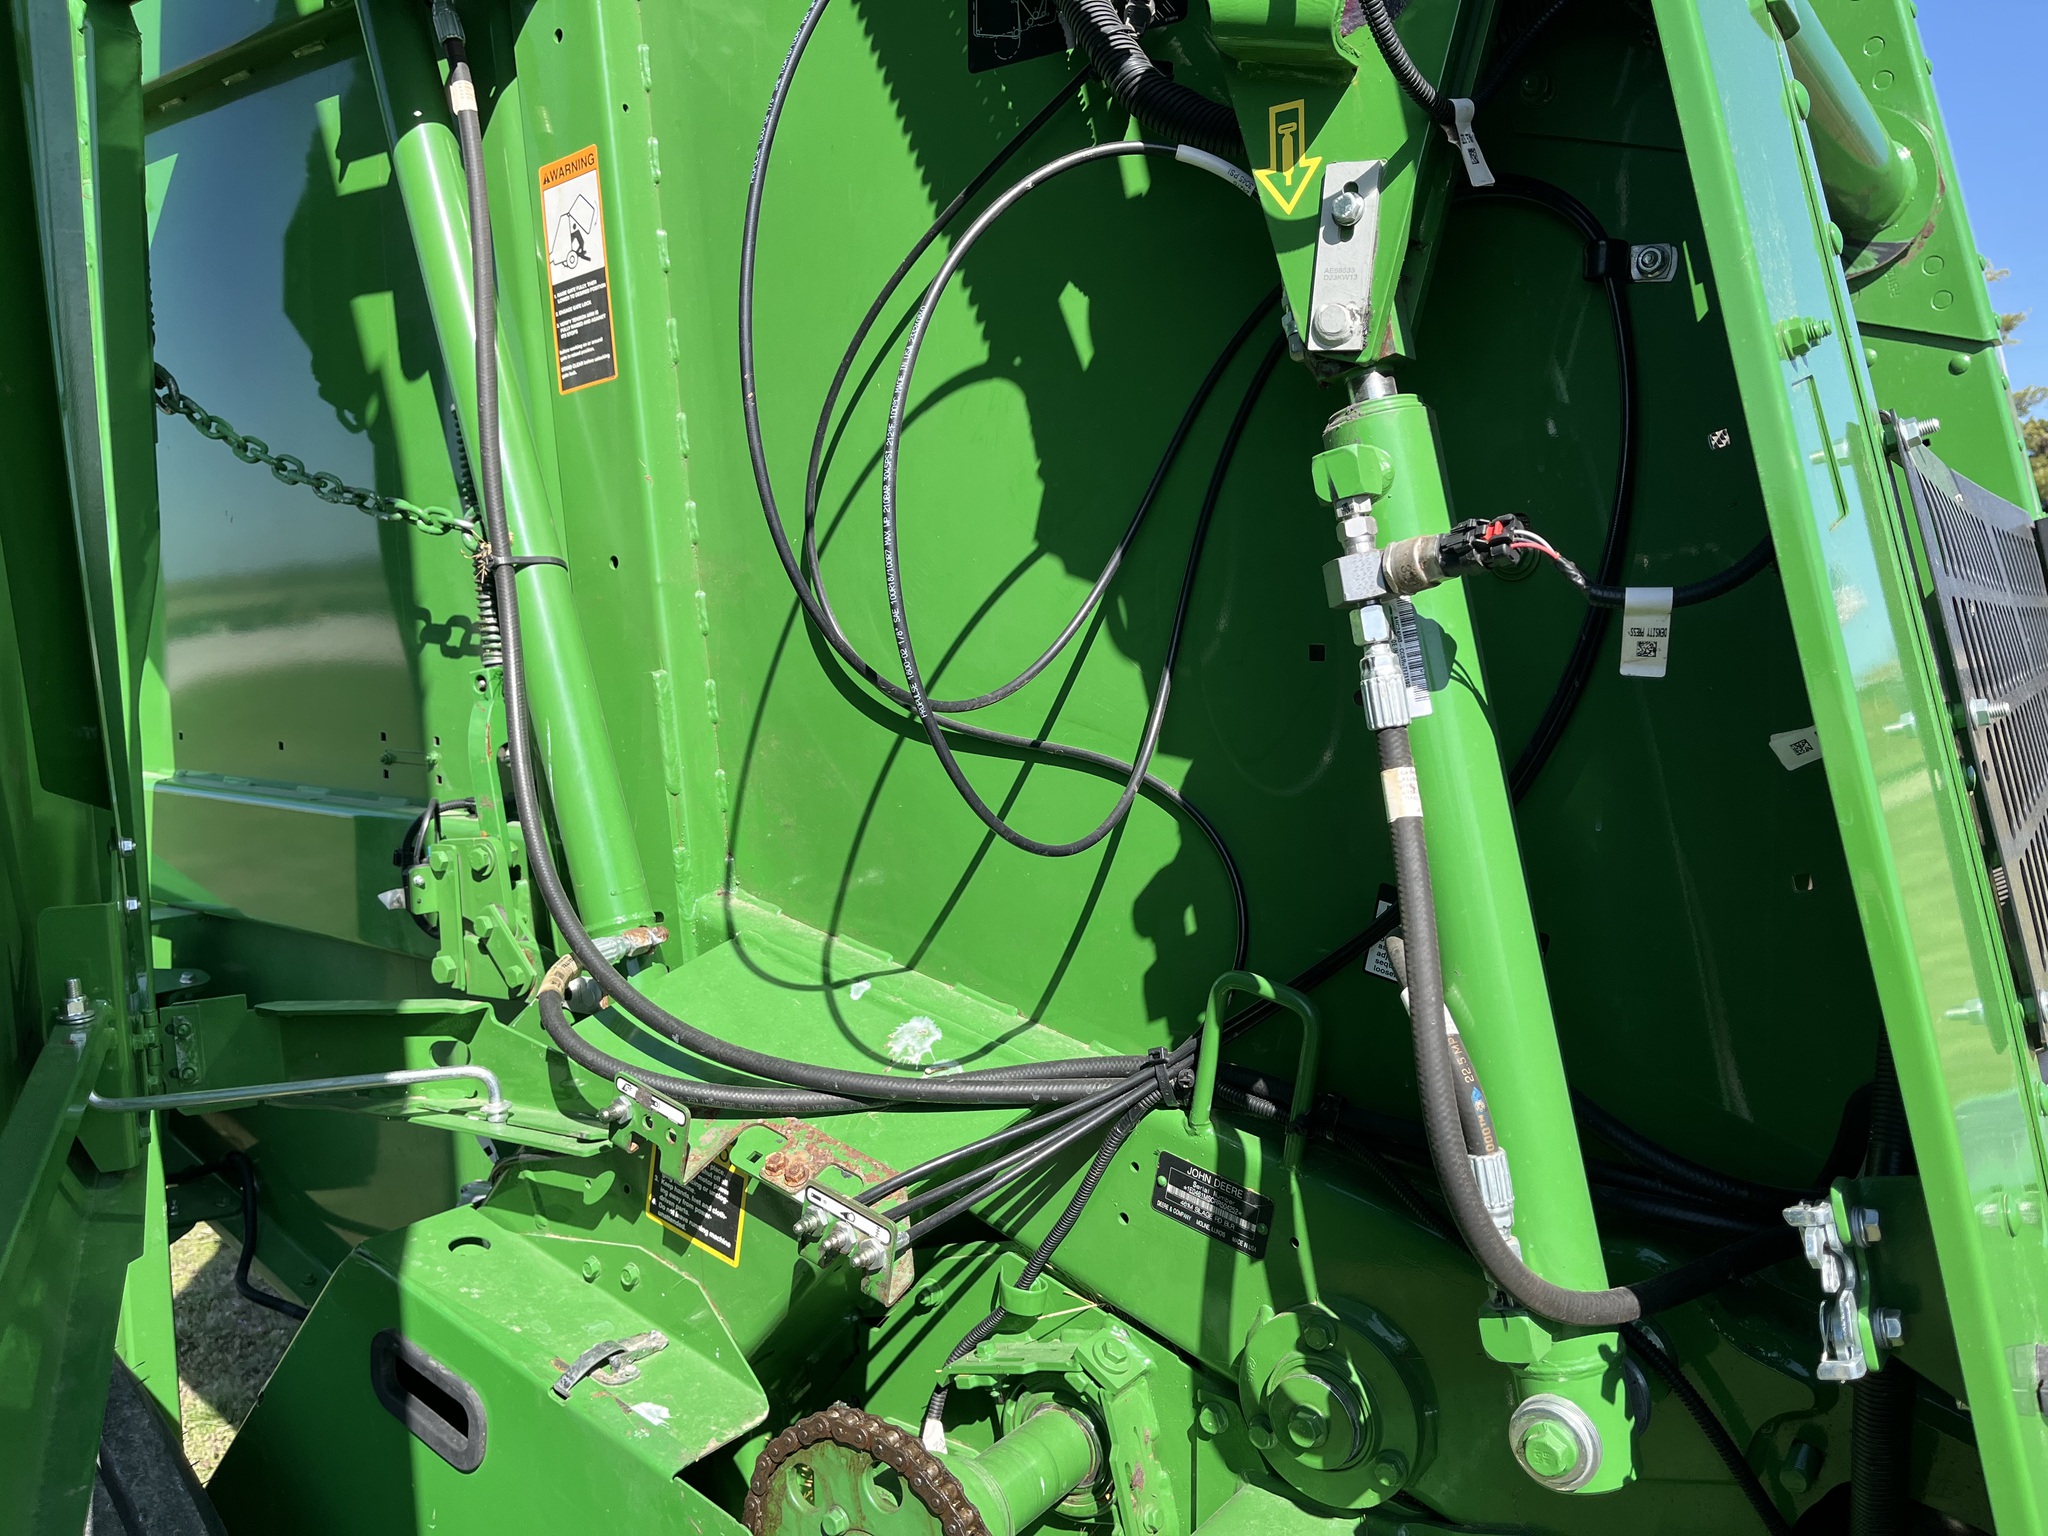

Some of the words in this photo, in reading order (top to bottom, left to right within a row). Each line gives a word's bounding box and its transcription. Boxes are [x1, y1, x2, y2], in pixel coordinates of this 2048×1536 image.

[550, 153, 595, 182] WARNING
[904, 345, 912, 359] USA
[895, 375, 904, 393] MADE
[883, 450, 893, 481] 3045PSI
[883, 484, 891, 513] 210BAR
[883, 516, 891, 527] WP
[884, 530, 892, 546] MAX
[892, 608, 900, 623] SAE
[1646, 627, 1668, 638] DENSITY
[900, 648, 914, 680] 1800-02
[910, 682, 928, 718] PROPULSE
[1457, 1057, 1474, 1083] 22.5
[661, 1178, 674, 1190] Keep
[1186, 1167, 1212, 1184] JOHN
[1214, 1178, 1244, 1199] DEERE
[1192, 1180, 1210, 1194] Serial
[709, 1231, 732, 1249] machine
